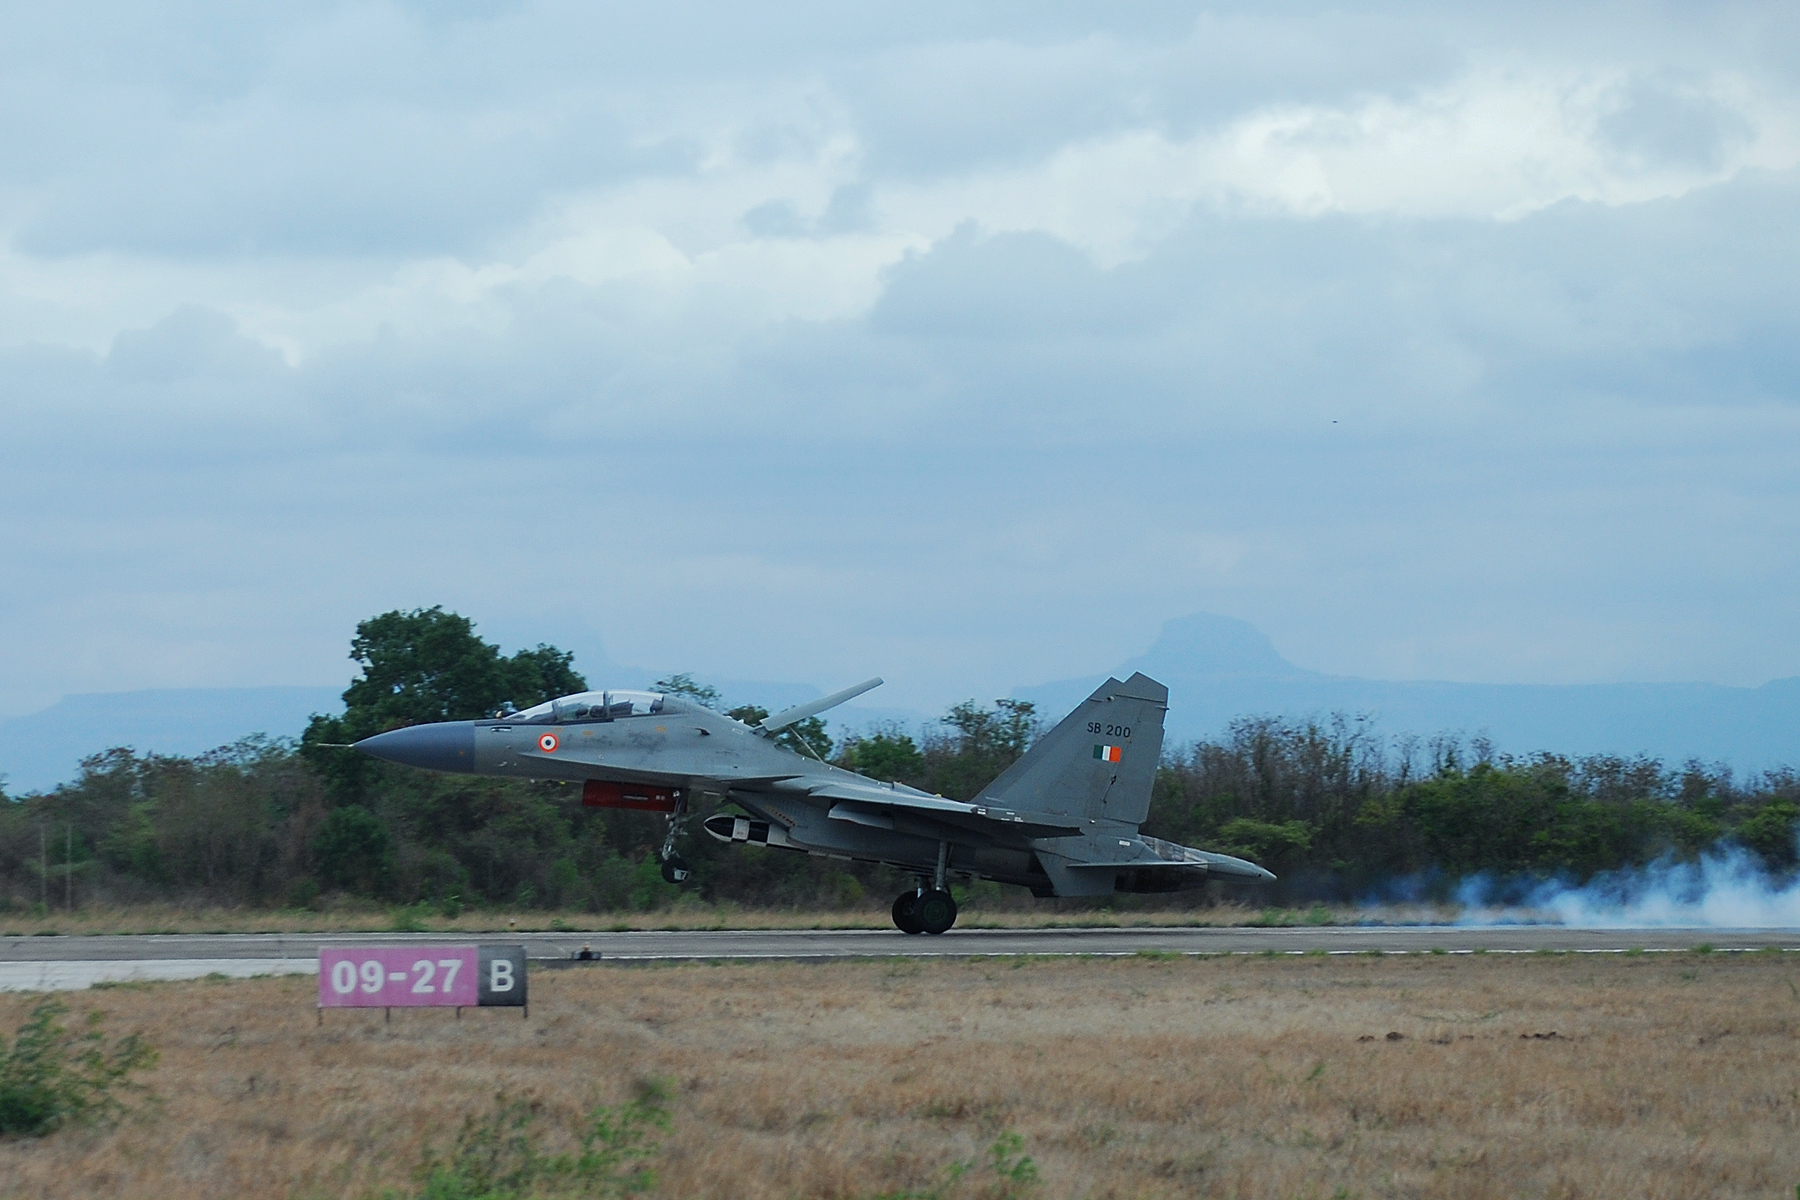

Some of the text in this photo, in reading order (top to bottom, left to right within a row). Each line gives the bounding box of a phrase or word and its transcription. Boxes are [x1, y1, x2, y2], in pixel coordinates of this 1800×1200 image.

[1087, 721, 1131, 738] SB 200
[331, 959, 515, 994] 09-27 B
